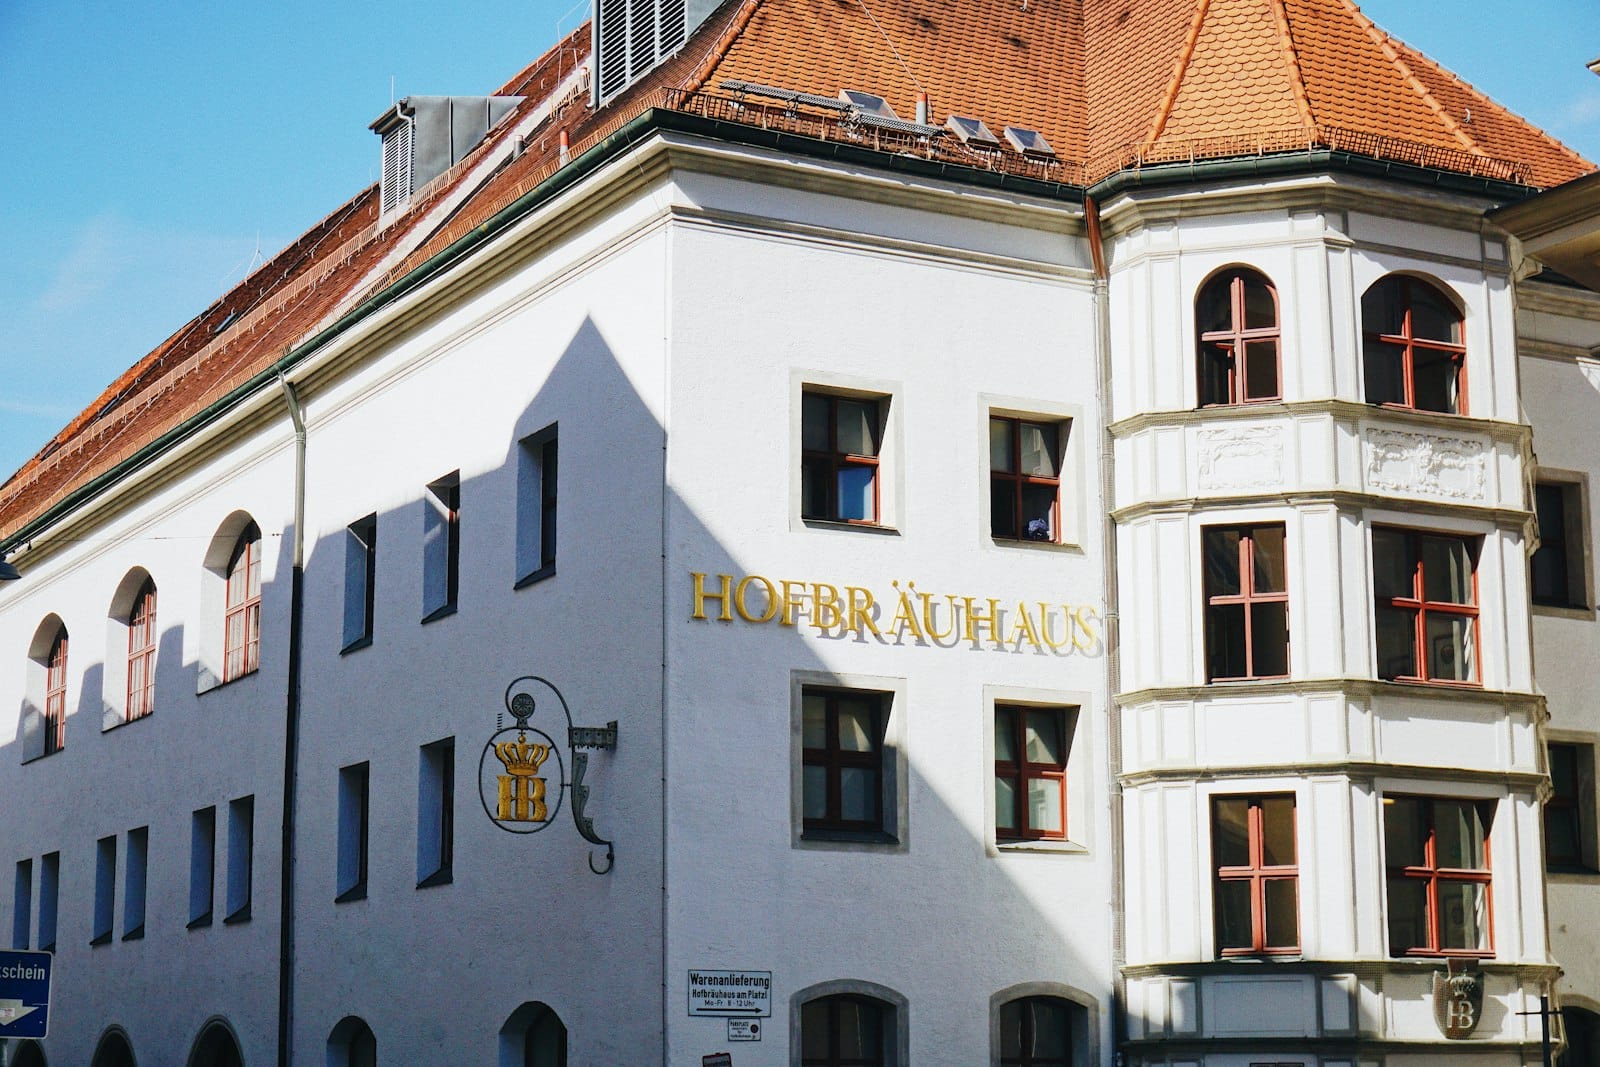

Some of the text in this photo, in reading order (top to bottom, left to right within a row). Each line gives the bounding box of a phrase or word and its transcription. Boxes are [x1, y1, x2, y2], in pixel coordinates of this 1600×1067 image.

[690, 572, 1099, 650] HOFBRÄUHAUS
[497, 775, 548, 821] HB
[0, 962, 46, 980] schein
[690, 973, 769, 989] Warenanlieferung
[692, 989, 735, 999] Hofbräuhaus
[748, 990, 767, 999] Platzl
[1447, 1000, 1475, 1029] HB
